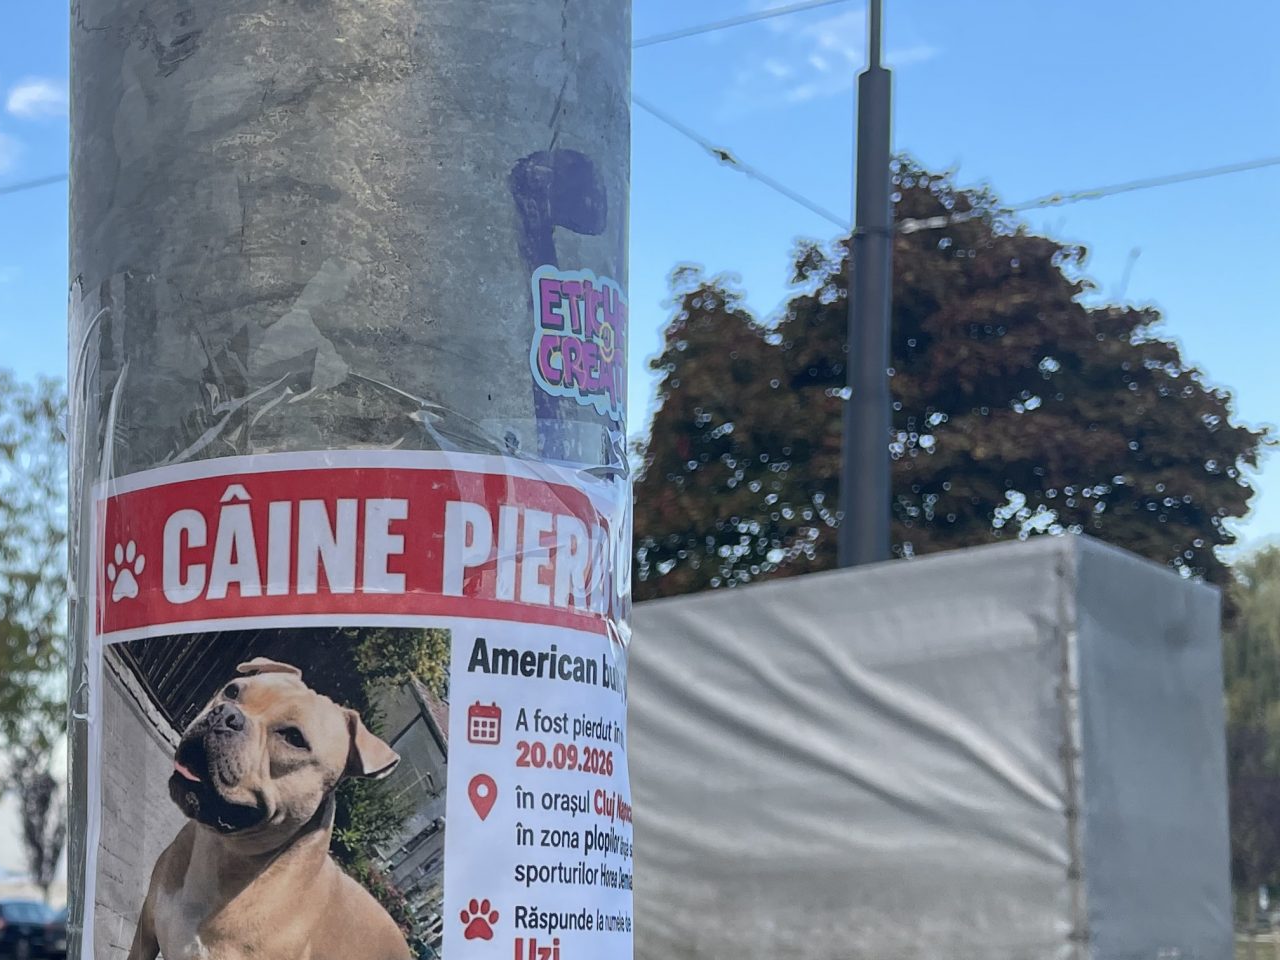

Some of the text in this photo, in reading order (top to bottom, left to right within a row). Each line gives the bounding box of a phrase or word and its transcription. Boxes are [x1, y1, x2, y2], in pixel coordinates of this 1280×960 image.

[162, 485, 409, 604] CÂINE
[467, 637, 598, 686] American
[515, 708, 529, 732] A
[534, 709, 569, 735] fost
[573, 713, 612, 741] pierdut
[516, 740, 613, 777] 20.09.2026
[515, 785, 534, 809] în
[541, 790, 590, 818] orașul
[593, 789, 615, 823] Cluj
[515, 822, 534, 846] în
[540, 829, 579, 849] zona
[514, 862, 599, 888] sporturilor
[514, 906, 593, 935] Răspunde
[596, 909, 603, 931] la
